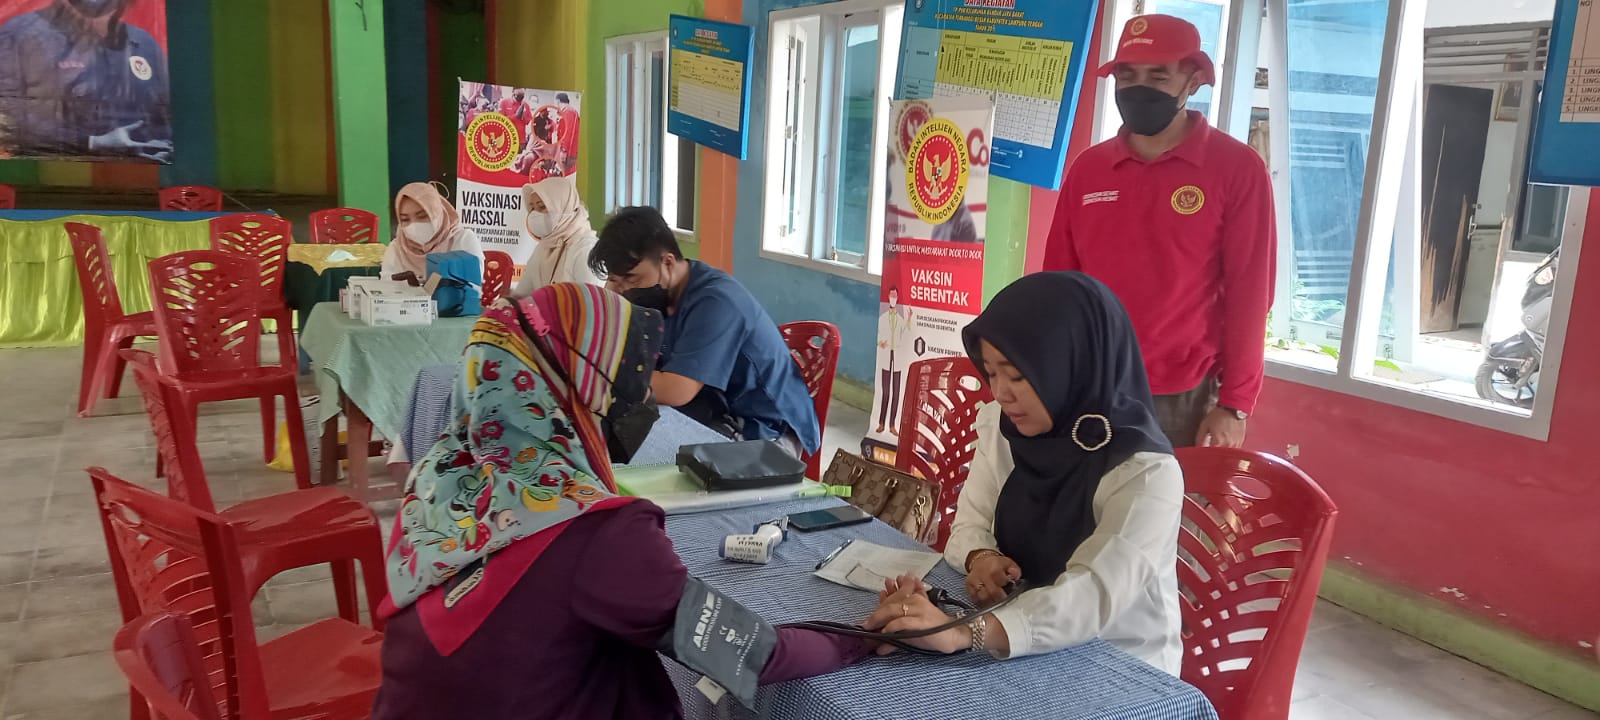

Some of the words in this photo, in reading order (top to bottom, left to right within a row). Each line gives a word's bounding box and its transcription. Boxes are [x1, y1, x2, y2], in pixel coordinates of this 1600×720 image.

[908, 140, 922, 174] BADAN
[920, 122, 952, 140] INTELIJEN
[952, 132, 966, 174] NEGARA
[462, 190, 522, 210] VAKSINASI
[908, 182, 932, 219] REPUBLIK
[932, 184, 964, 220] INDONESIA
[461, 208, 507, 227] MASSAL
[476, 228, 505, 236] MASYARAKAT
[948, 248, 962, 258] DOOR
[962, 249, 968, 258] TO
[969, 250, 982, 260] DOOR
[911, 268, 953, 287] VAKSIN
[910, 286, 969, 306] SERENTAK
[928, 346, 944, 355] VAKSIN
[693, 608, 712, 648] ABN
